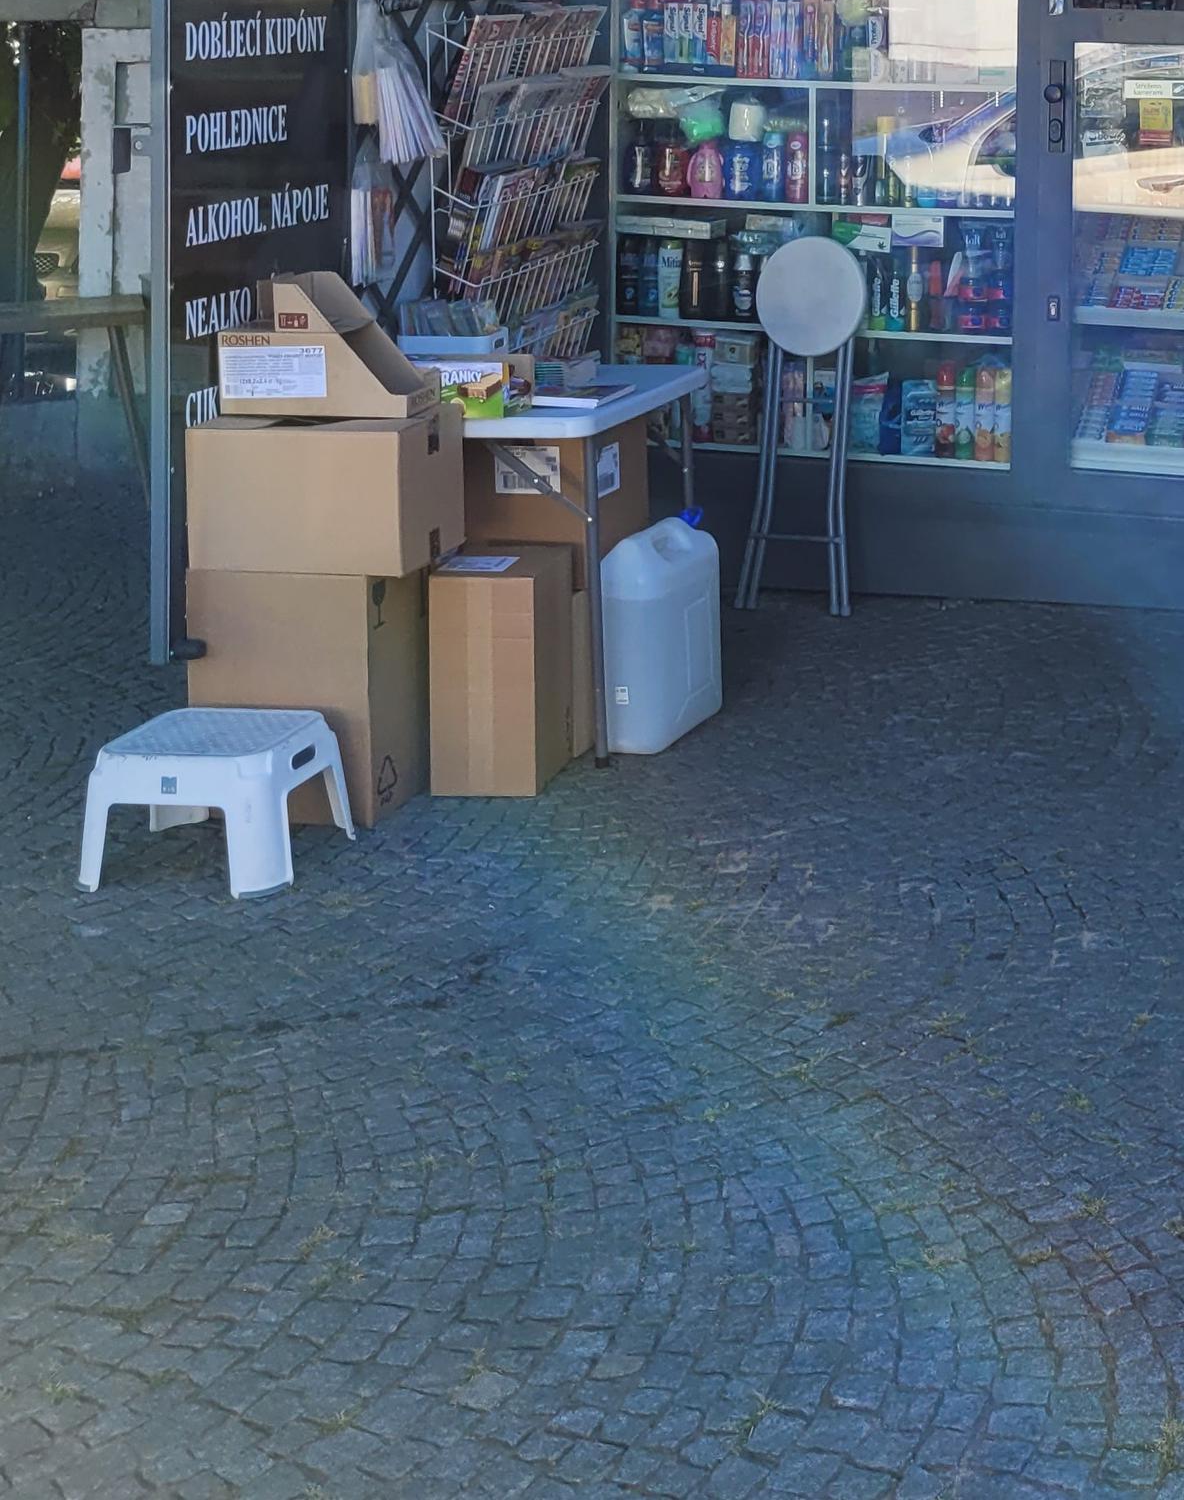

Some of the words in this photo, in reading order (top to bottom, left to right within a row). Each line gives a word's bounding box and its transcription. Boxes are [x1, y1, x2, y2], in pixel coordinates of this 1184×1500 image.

[185, 10, 262, 61] DOBÍJECÍ
[265, 8, 327, 55] KUPÓNY
[185, 104, 287, 155] POHLEDNICE
[185, 195, 268, 247] ALKOHOL.
[271, 182, 329, 229] NÁPOJE
[185, 286, 251, 341] NEALKO
[221, 334, 271, 346] ROSHEN
[441, 369, 483, 386] RANKY
